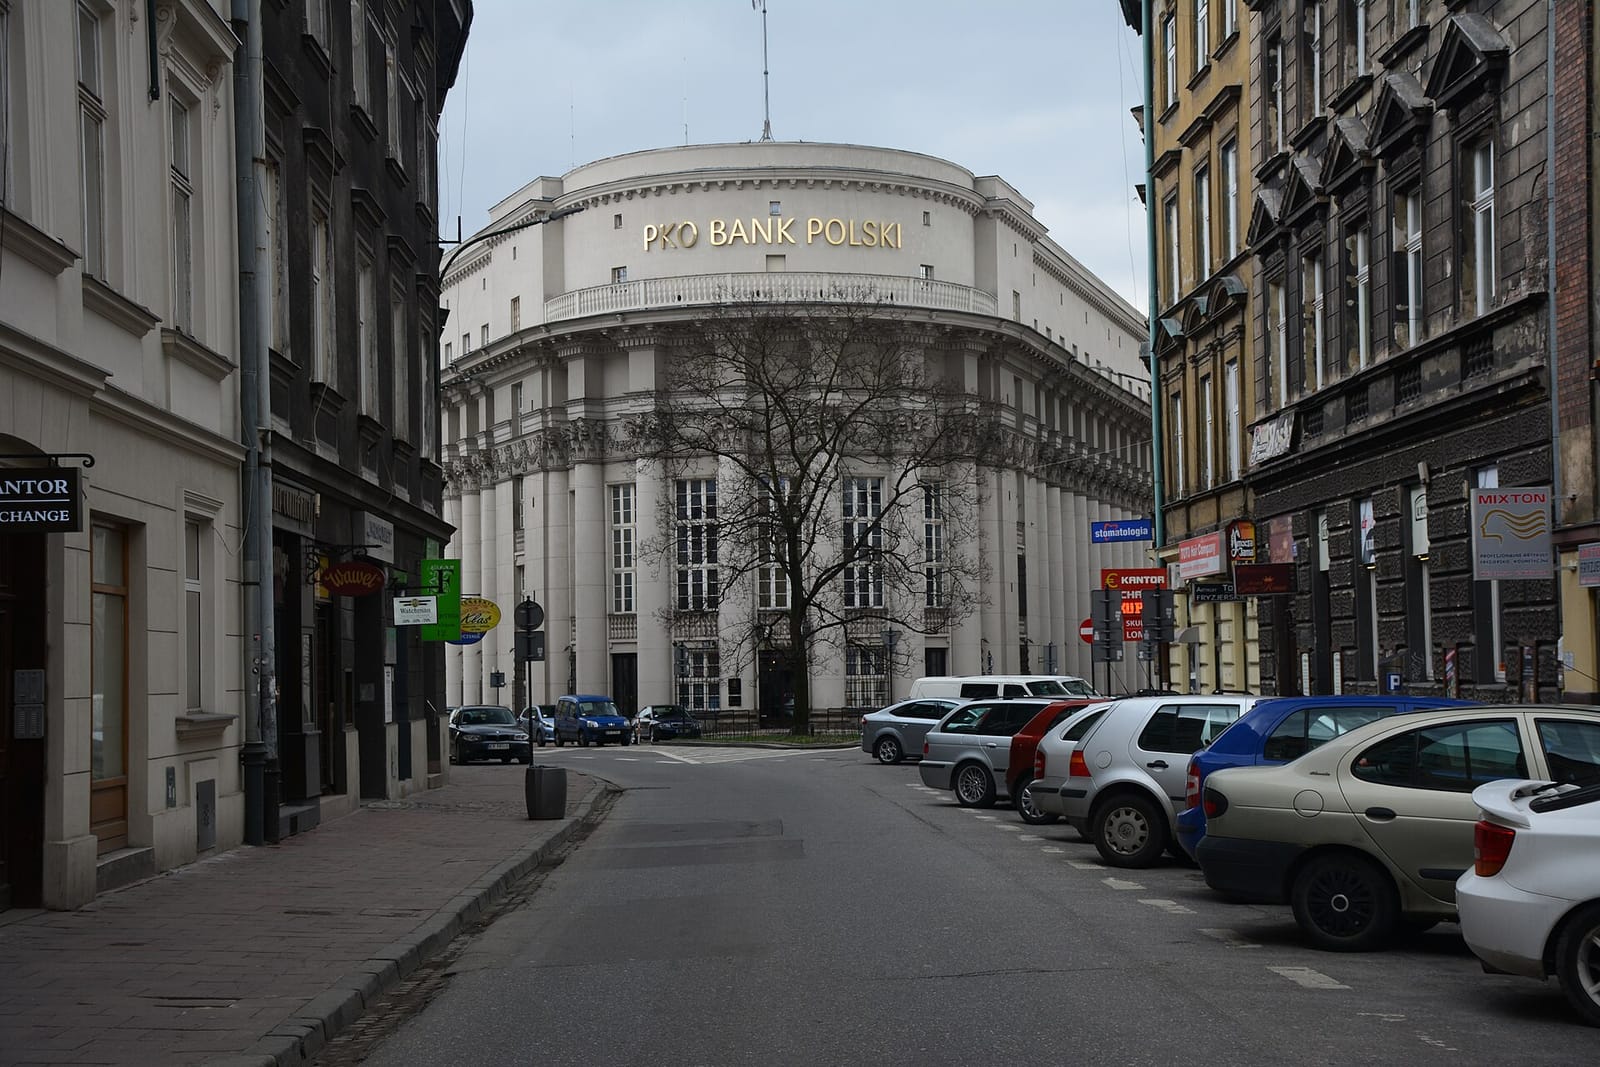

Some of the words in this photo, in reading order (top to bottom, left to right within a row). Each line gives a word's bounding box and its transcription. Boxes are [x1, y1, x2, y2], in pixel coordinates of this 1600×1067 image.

[643, 223, 698, 251] PKO
[710, 217, 796, 246] BANK
[806, 217, 903, 249] POLSKI
[1478, 493, 1546, 505] MIXTON
[1095, 526, 1149, 538] stomatologia
[326, 568, 378, 588] Wawel
[1121, 575, 1165, 585] KANTOR
[1390, 675, 1401, 690] P
